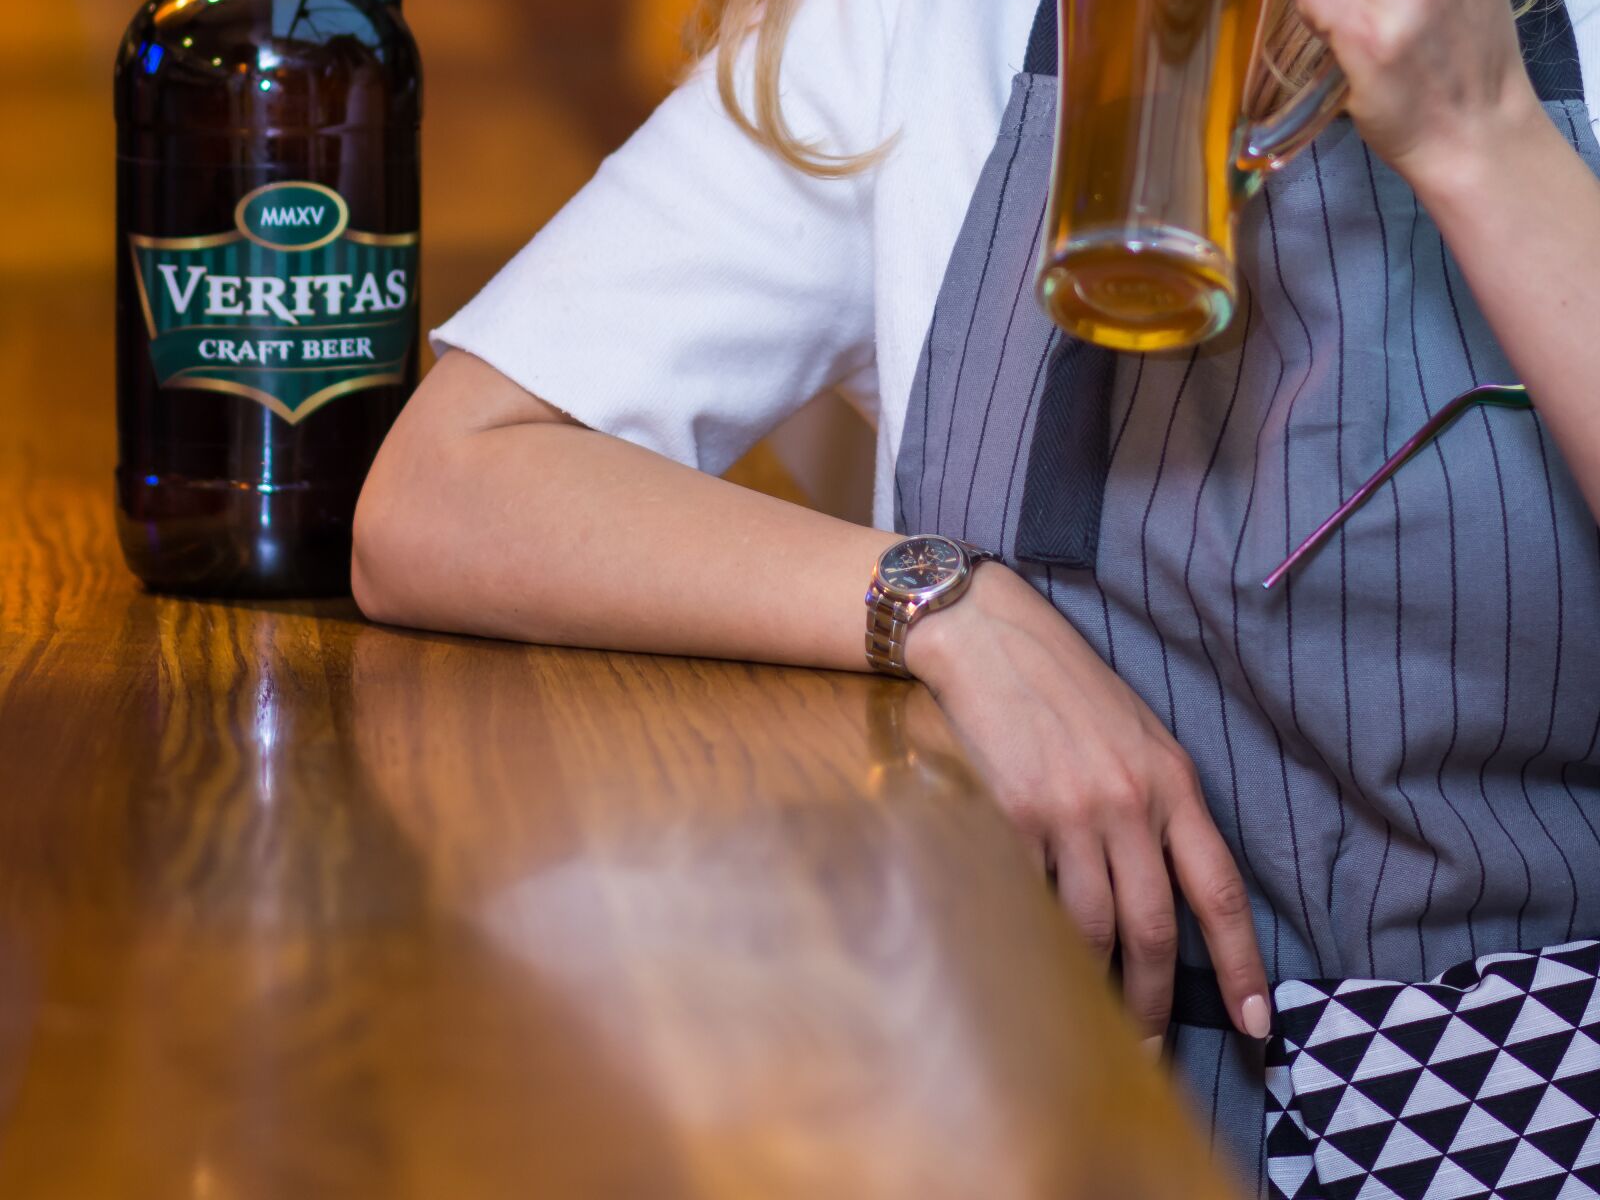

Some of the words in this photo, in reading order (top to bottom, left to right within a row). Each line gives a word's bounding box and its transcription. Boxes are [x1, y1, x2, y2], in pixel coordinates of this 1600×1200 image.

[261, 206, 324, 226] MMXV
[157, 264, 407, 325] VERITAS
[199, 339, 293, 365] CRAFT
[302, 337, 374, 359] BEER
